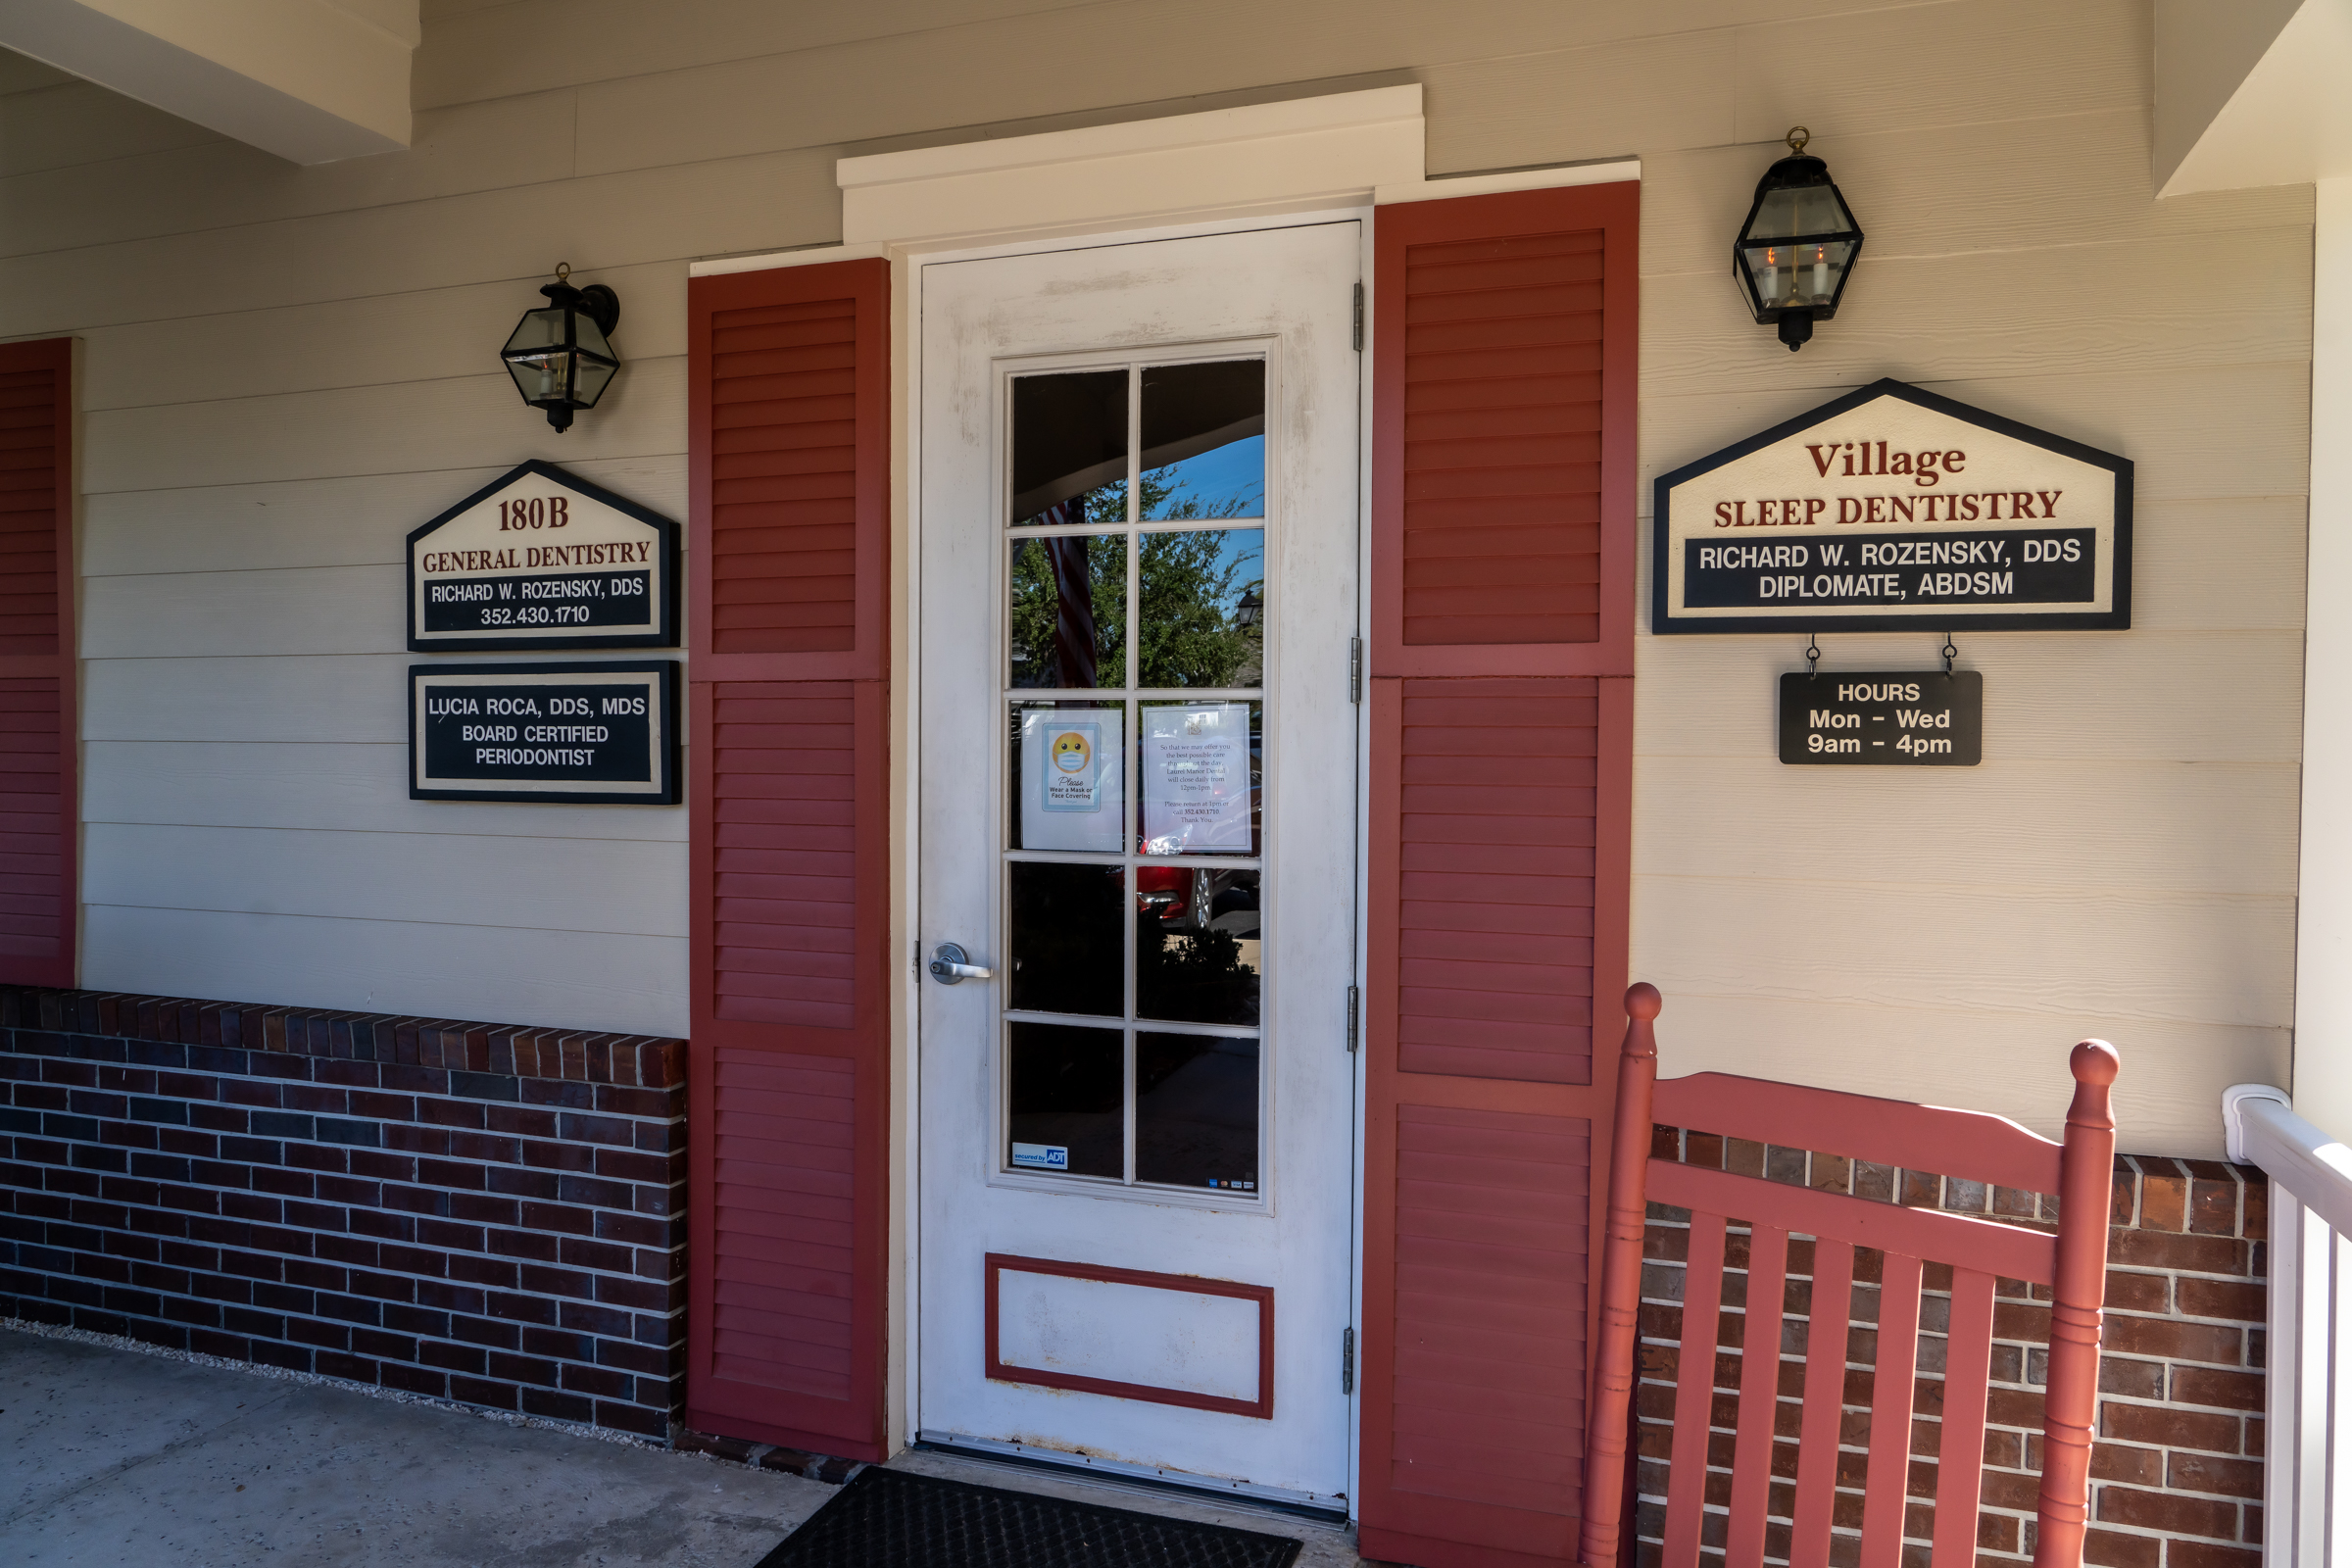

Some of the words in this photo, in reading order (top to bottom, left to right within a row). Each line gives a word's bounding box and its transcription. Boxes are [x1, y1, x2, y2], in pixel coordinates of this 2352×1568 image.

[1805, 441, 1966, 486] Village
[498, 496, 569, 531] 180B
[1714, 498, 1827, 528] SLEEP
[1838, 490, 2063, 524] DENTISTRY
[422, 549, 521, 573] GENERAL
[525, 541, 651, 568] DENTISTRY
[1699, 545, 1809, 569] RICHARD
[1820, 544, 1849, 566] W.
[1861, 540, 2011, 568] ROZENSKY,
[2023, 539, 2081, 563] DDS
[431, 584, 493, 603] RICHARD
[499, 583, 515, 600] W.
[521, 579, 606, 600] ROZENSKY,
[611, 577, 644, 596] DDS
[1759, 573, 1906, 601] DIPLOMATE,
[1917, 571, 2014, 596] ABDSM
[480, 606, 590, 625] 352.430.1710
[1838, 683, 1921, 702] HOURS
[428, 698, 479, 715] LUCIA
[486, 698, 542, 718] ROCA,
[550, 698, 594, 718] DDS,
[602, 698, 646, 715] MDS
[1809, 710, 1861, 729] Mon
[1895, 709, 1951, 728] Wed
[463, 725, 517, 742] BOARD
[524, 725, 609, 743] CERTIFIED
[1807, 734, 1861, 755] 9am
[1895, 734, 1952, 757] 4pm
[475, 748, 595, 766] PERIODONTIST
[1057, 776, 1084, 786] Please
[1047, 1152, 1064, 1163] ADT
